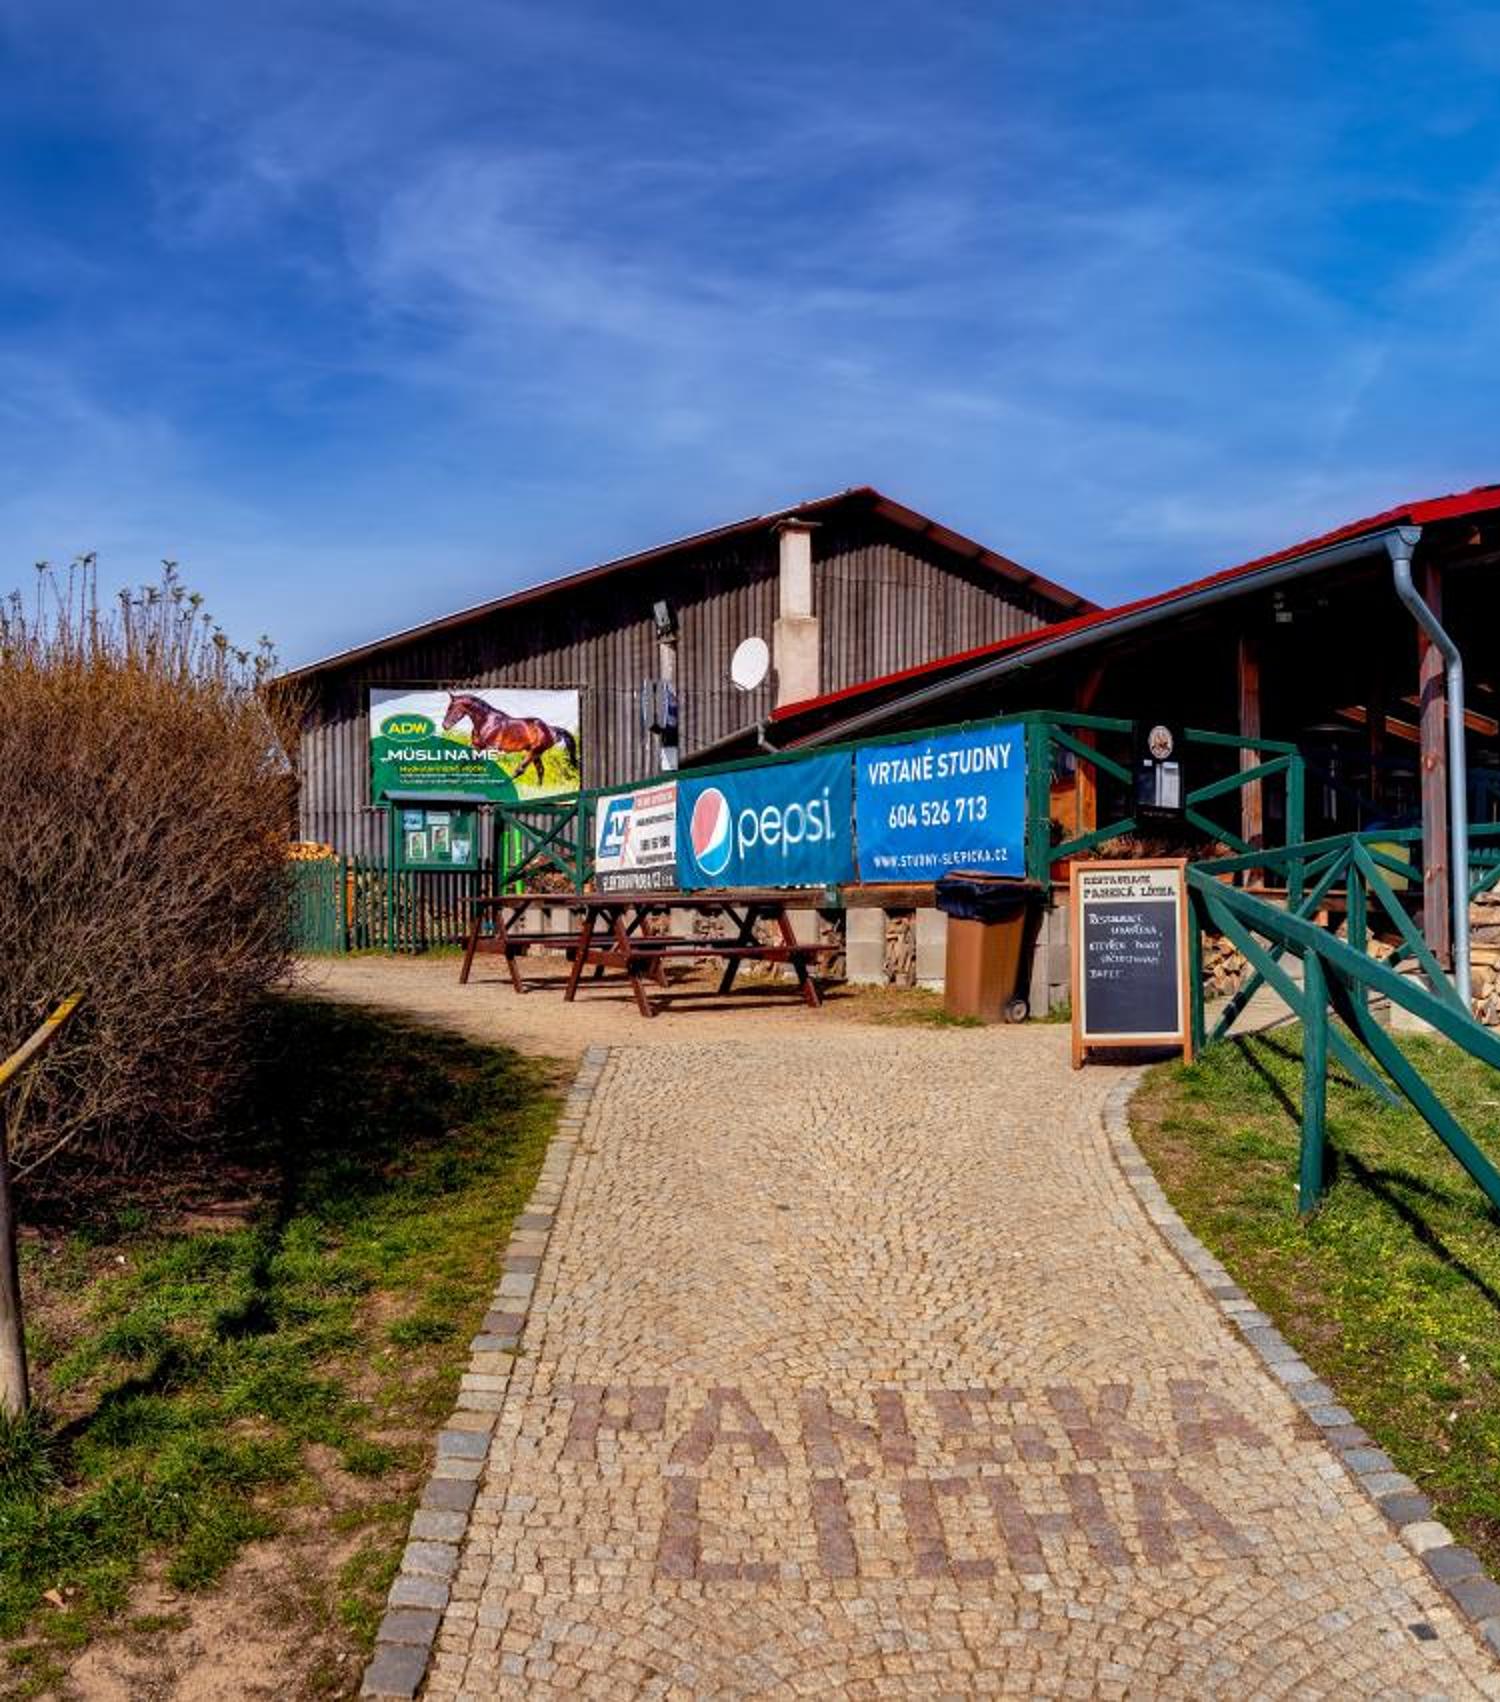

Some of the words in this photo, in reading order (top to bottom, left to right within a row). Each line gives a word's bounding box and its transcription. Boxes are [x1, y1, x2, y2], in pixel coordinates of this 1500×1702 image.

[388, 722, 427, 734] ADW
[445, 749, 471, 761] NA
[868, 748, 933, 785] VRTANÉ
[937, 743, 1011, 777] STUDNY
[738, 786, 831, 860] pepsi
[889, 803, 917, 829] 604
[921, 800, 950, 826] 526
[955, 796, 987, 823] 713
